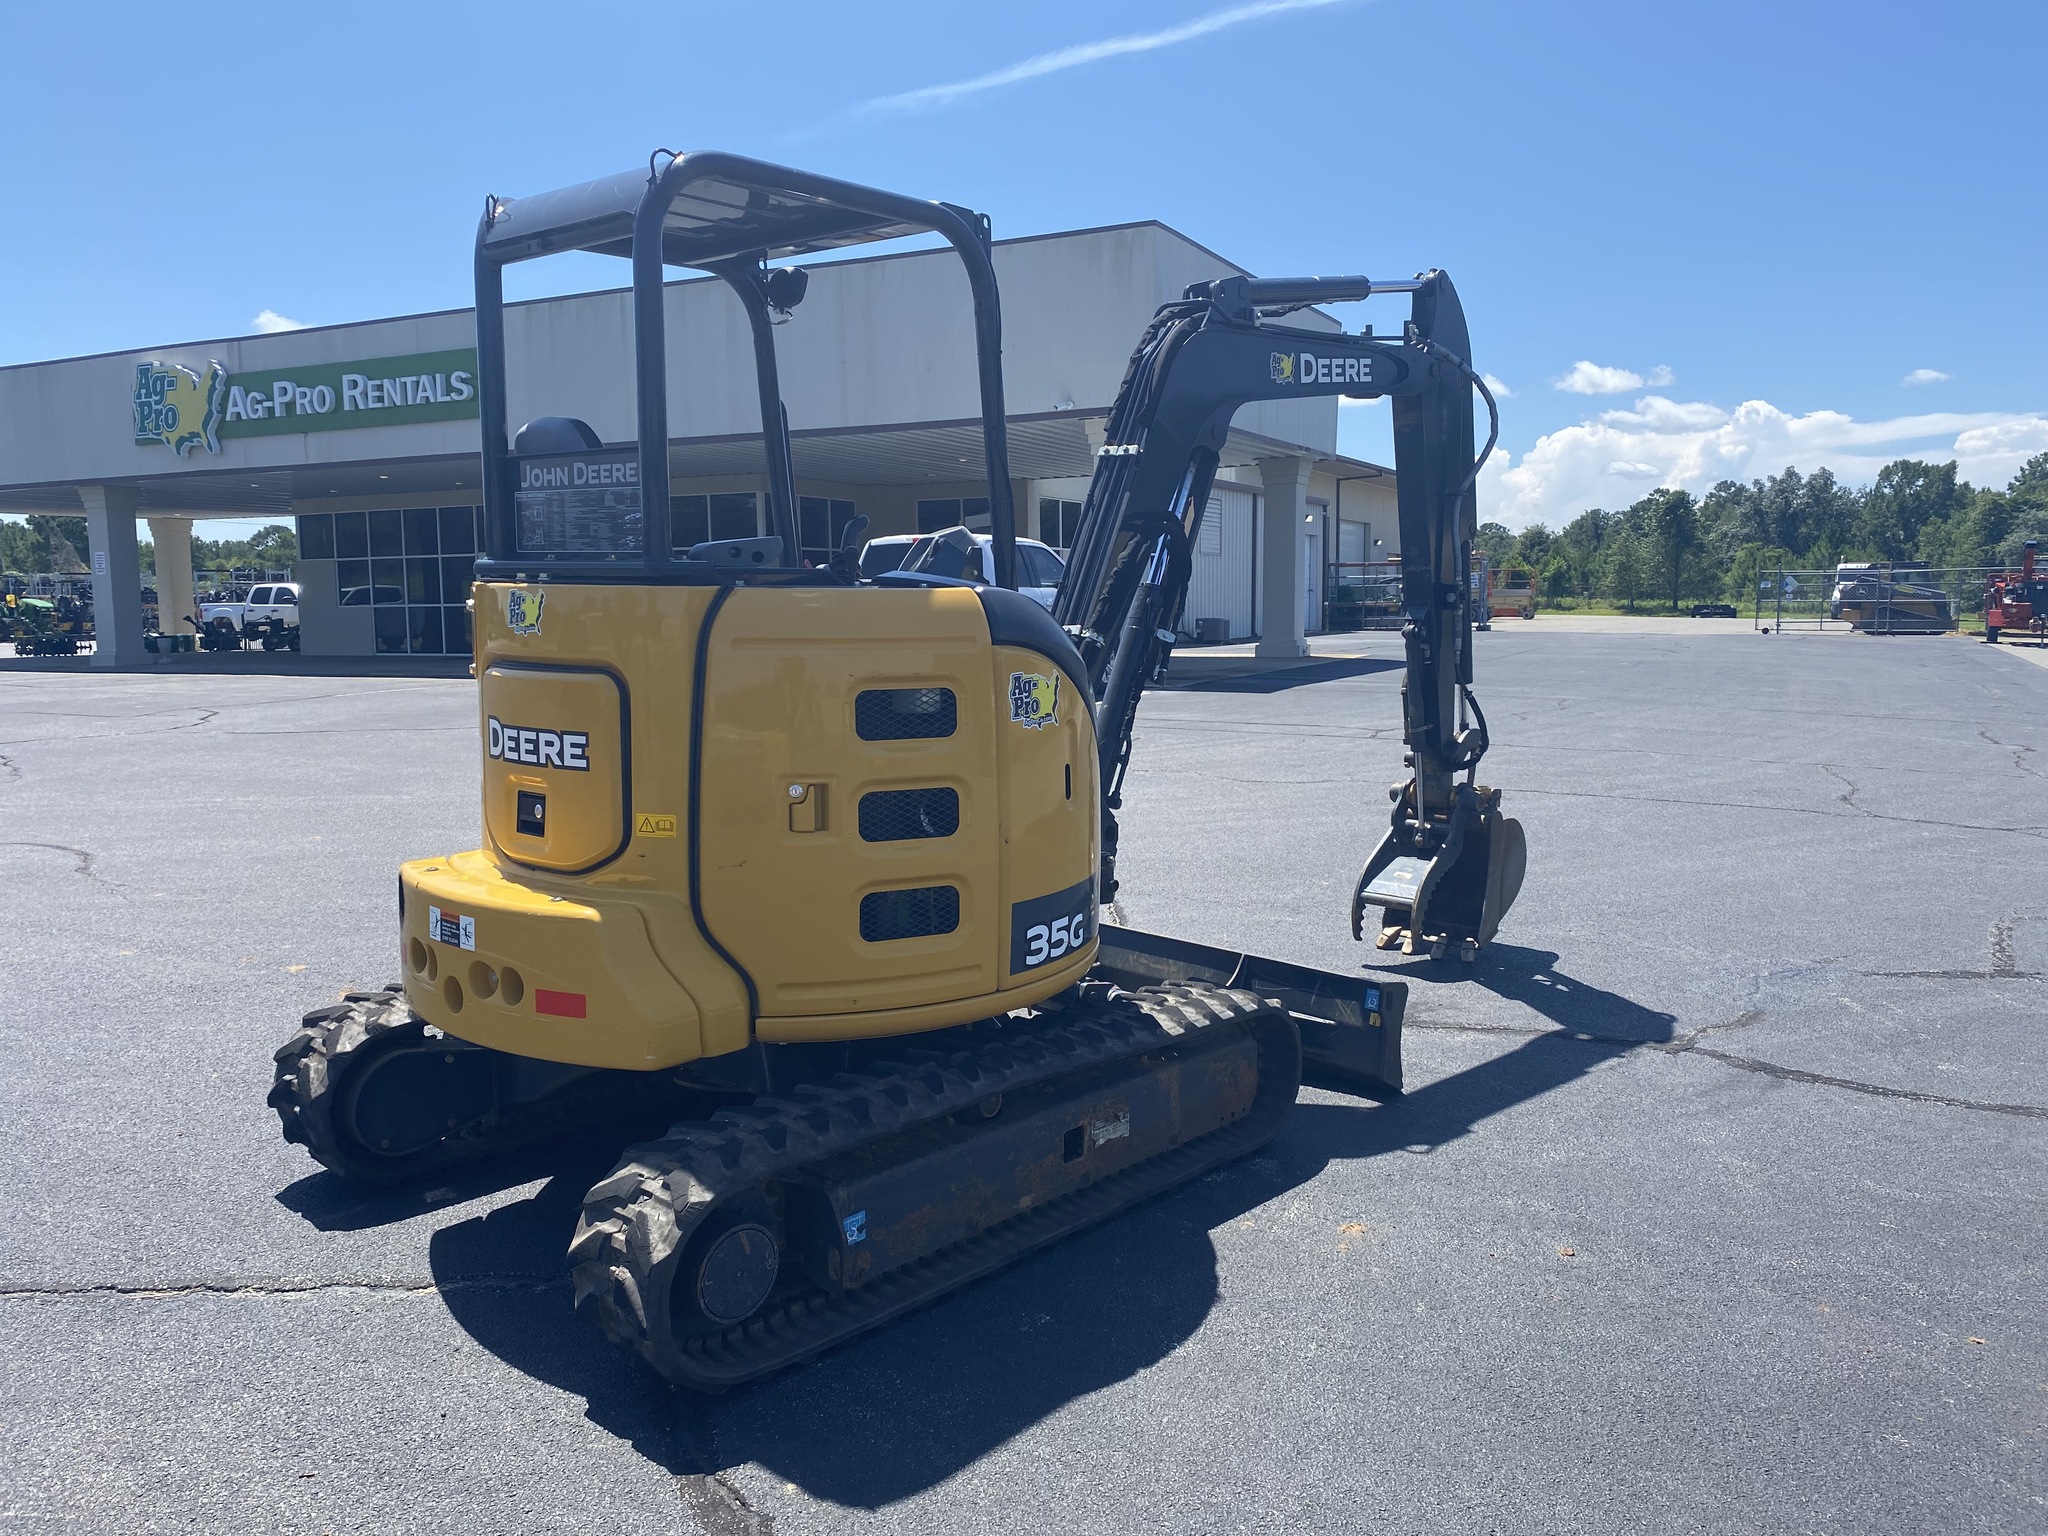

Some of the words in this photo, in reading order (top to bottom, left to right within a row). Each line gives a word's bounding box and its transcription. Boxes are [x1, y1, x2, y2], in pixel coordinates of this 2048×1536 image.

[1300, 353, 1372, 384] DEERE
[342, 371, 474, 411] RENTALS
[136, 401, 179, 435] Pro
[521, 465, 569, 488] JOHN
[573, 462, 638, 485] DEERE
[509, 608, 526, 625] Pro
[1012, 697, 1040, 719] Pro
[488, 717, 588, 768] DEERE
[1025, 913, 1084, 965] 35G
